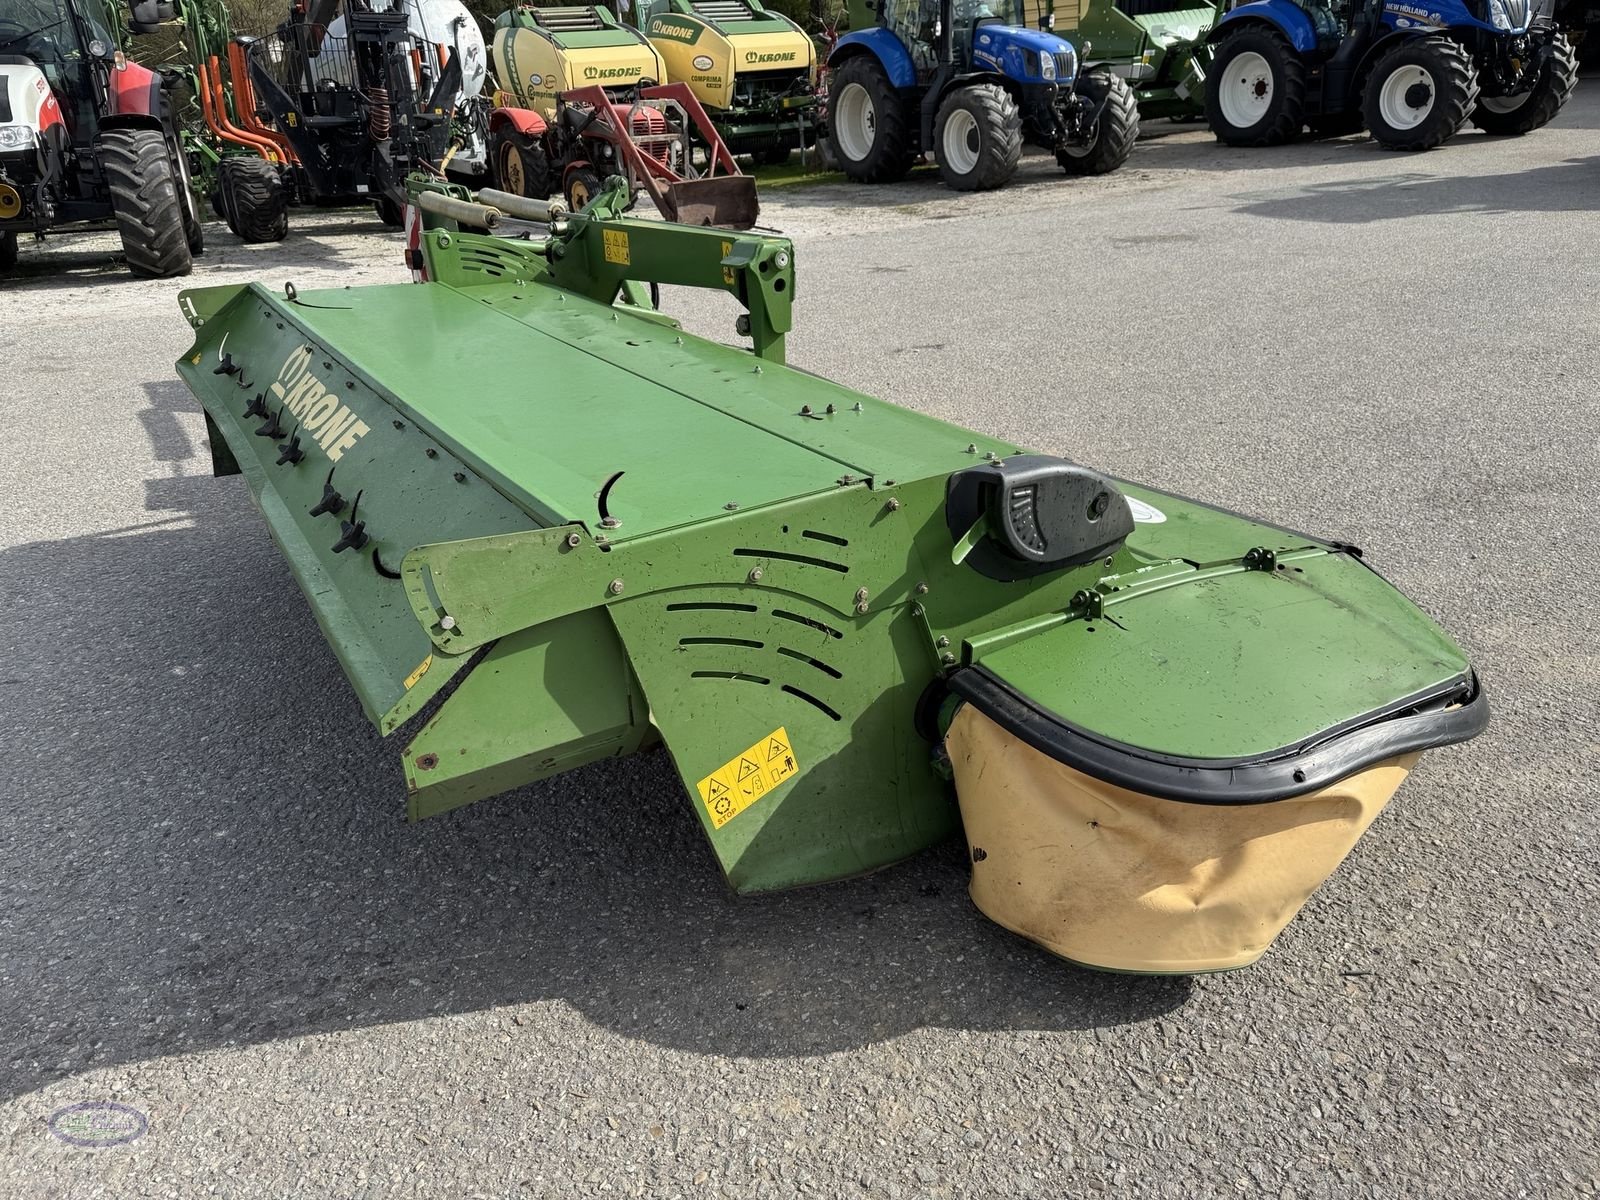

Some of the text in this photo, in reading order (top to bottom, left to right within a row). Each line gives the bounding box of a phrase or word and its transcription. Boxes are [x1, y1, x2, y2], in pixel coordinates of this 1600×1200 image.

[1400, 5, 1428, 17] HOLLAND
[660, 24, 694, 39] KRONE
[758, 52, 796, 63] KRONE
[598, 66, 642, 79] KRONE
[691, 75, 722, 83] COMPRIMA
[283, 370, 371, 463] KRONE
[717, 807, 737, 825] STOP
